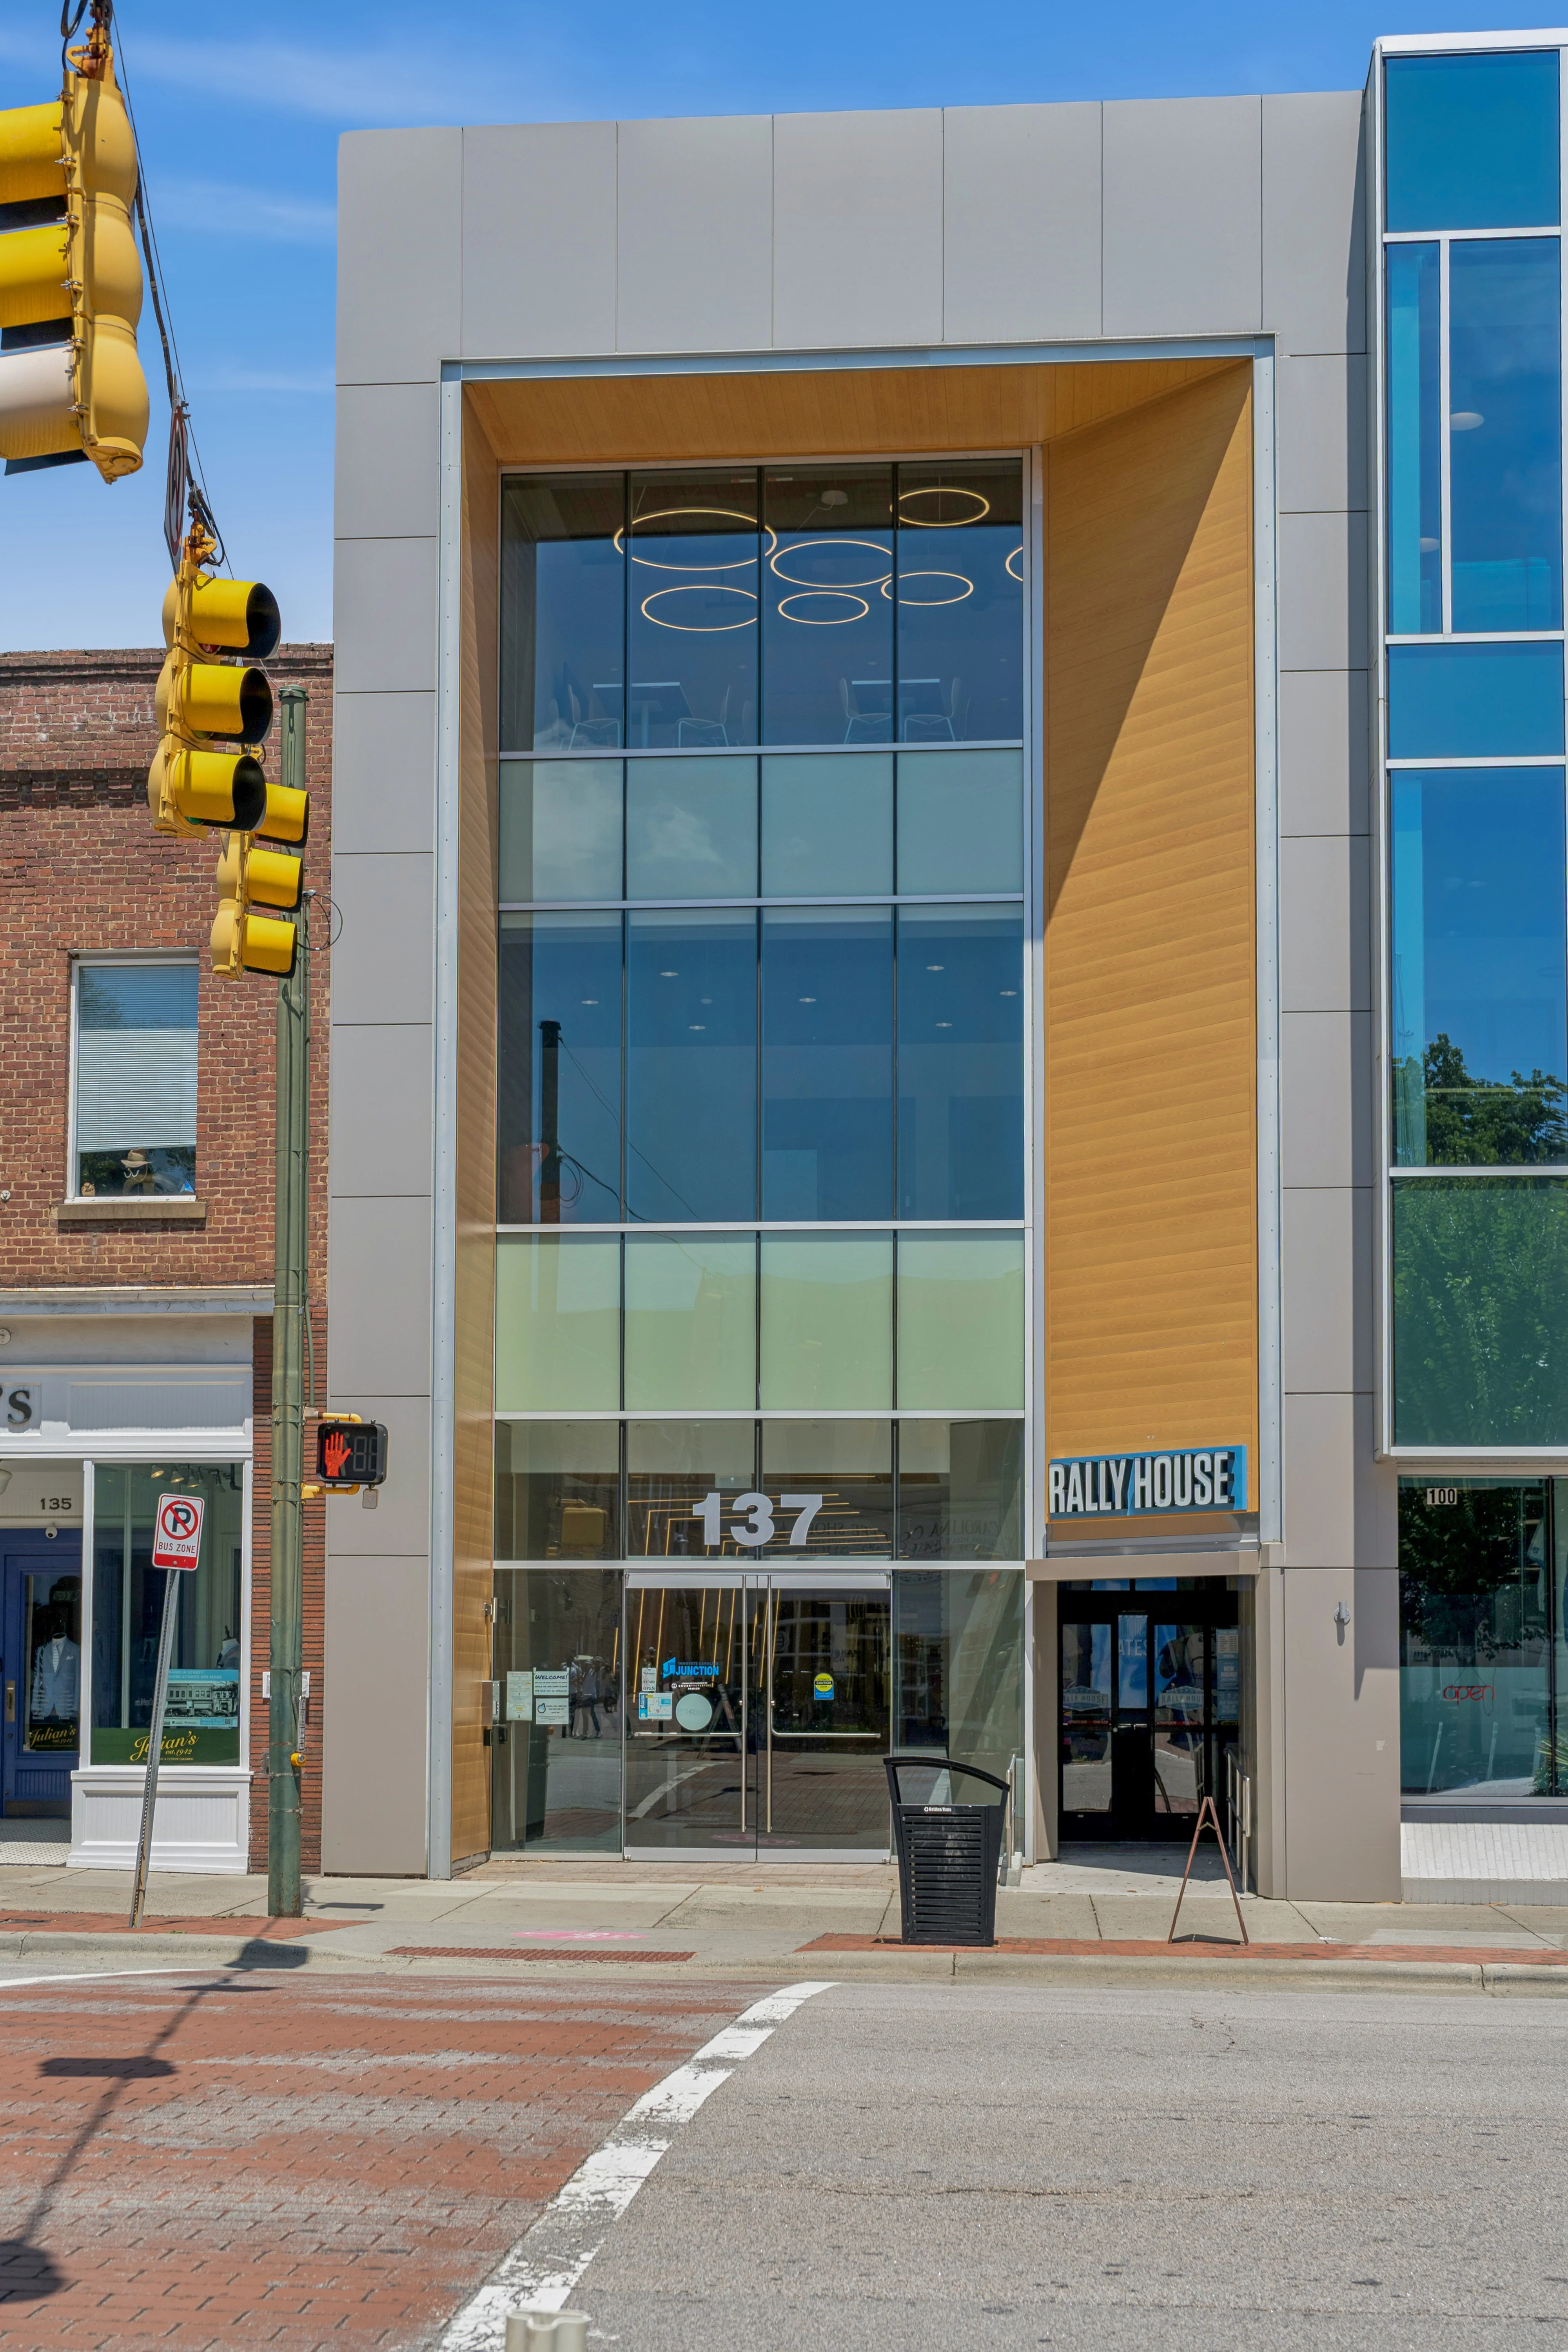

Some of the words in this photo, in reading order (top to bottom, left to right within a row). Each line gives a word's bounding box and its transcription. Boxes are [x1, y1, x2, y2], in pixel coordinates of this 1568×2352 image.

[1049, 1458, 1129, 1514] RALLY
[1134, 1451, 1232, 1508] HOUSE
[40, 1498, 72, 1510] 135
[1429, 1489, 1455, 1504] 100
[693, 1493, 822, 1546] 137
[158, 1542, 173, 1551] BUS
[176, 1544, 196, 1553] ZONE
[676, 1666, 719, 1675] JUNCTION
[1161, 1694, 1183, 1704] RALLY
[1444, 1686, 1495, 1705] open
[29, 1725, 77, 1747] Julian's
